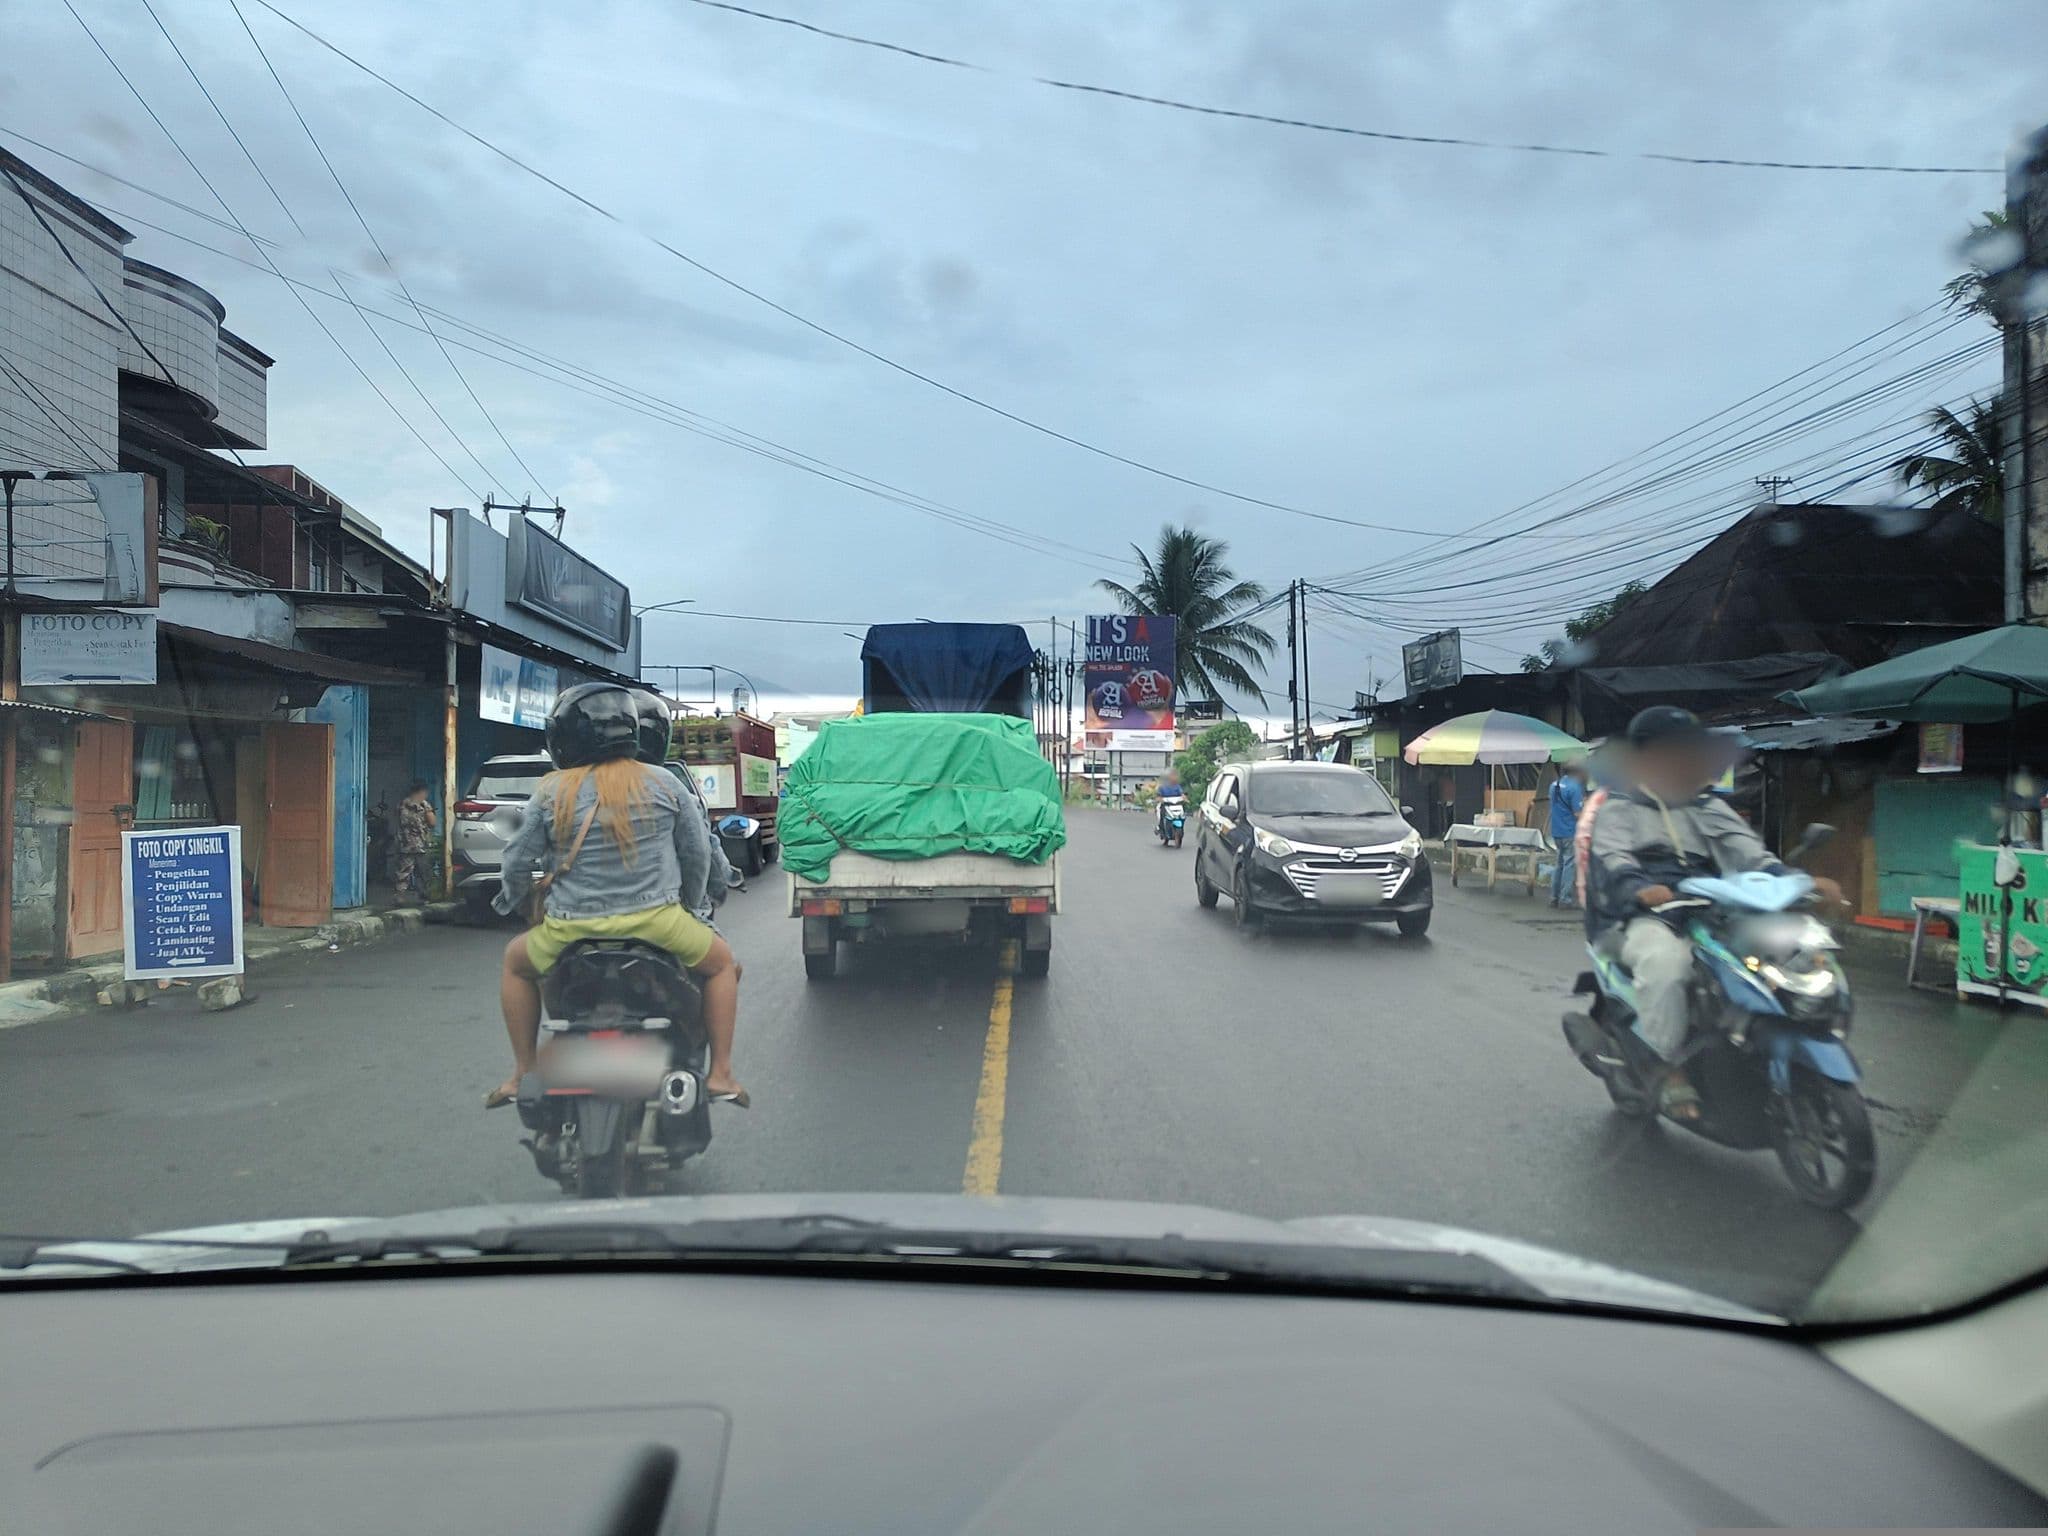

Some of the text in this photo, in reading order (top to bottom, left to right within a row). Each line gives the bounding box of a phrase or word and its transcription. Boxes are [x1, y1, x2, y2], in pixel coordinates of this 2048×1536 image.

[31, 615, 148, 631] FOTO COPY
[1085, 615, 1151, 644] IT'S A
[1085, 645, 1150, 662] NEW LOOK
[138, 837, 224, 858] FOTO COPY SINGKIL
[154, 868, 210, 879] Pengetikan
[155, 880, 209, 892] Penjilidan
[155, 891, 223, 903] Copy Warna
[155, 904, 208, 914] Undangan
[155, 914, 180, 924] Scan
[188, 912, 210, 922] Edit
[156, 924, 212, 934] Cetak Foto
[156, 935, 216, 946] Laminating
[156, 947, 179, 957] Jual
